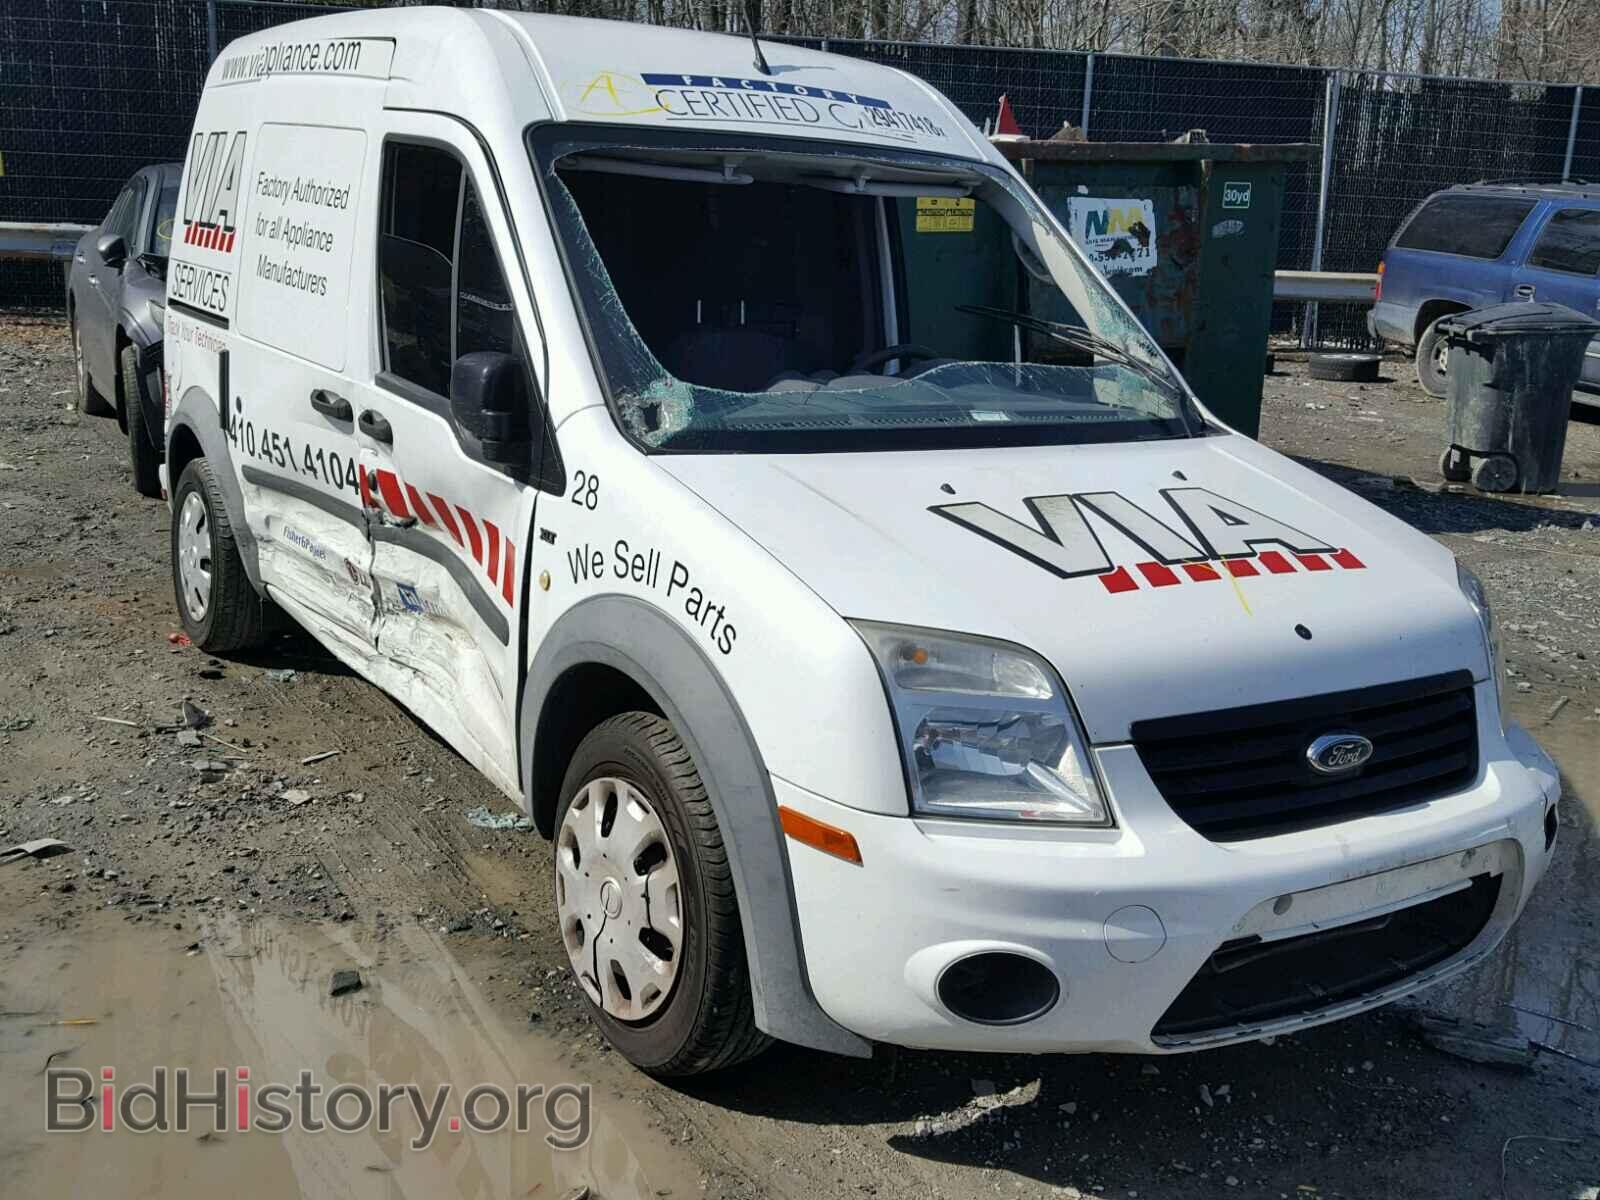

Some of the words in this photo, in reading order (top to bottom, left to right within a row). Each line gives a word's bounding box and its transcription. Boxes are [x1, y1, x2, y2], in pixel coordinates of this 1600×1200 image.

[655, 88, 820, 124] CERTIFIED
[682, 75, 858, 105] FACTORY
[183, 131, 248, 233] VIA
[256, 171, 290, 206] Factory
[290, 176, 350, 209] Authorized
[1223, 189, 1250, 205] 30yd
[256, 212, 269, 238] for
[268, 216, 283, 240] all
[281, 217, 333, 252] Appliance
[172, 262, 230, 312] SERVICES
[256, 254, 328, 297] Manufacturers
[228, 415, 360, 495] 410.451.4104
[571, 470, 599, 511] 28
[926, 486, 1339, 579] VIA
[567, 543, 604, 584] We
[613, 540, 661, 588] Sell
[667, 560, 737, 655] Parts
[1328, 743, 1362, 766] Ford
